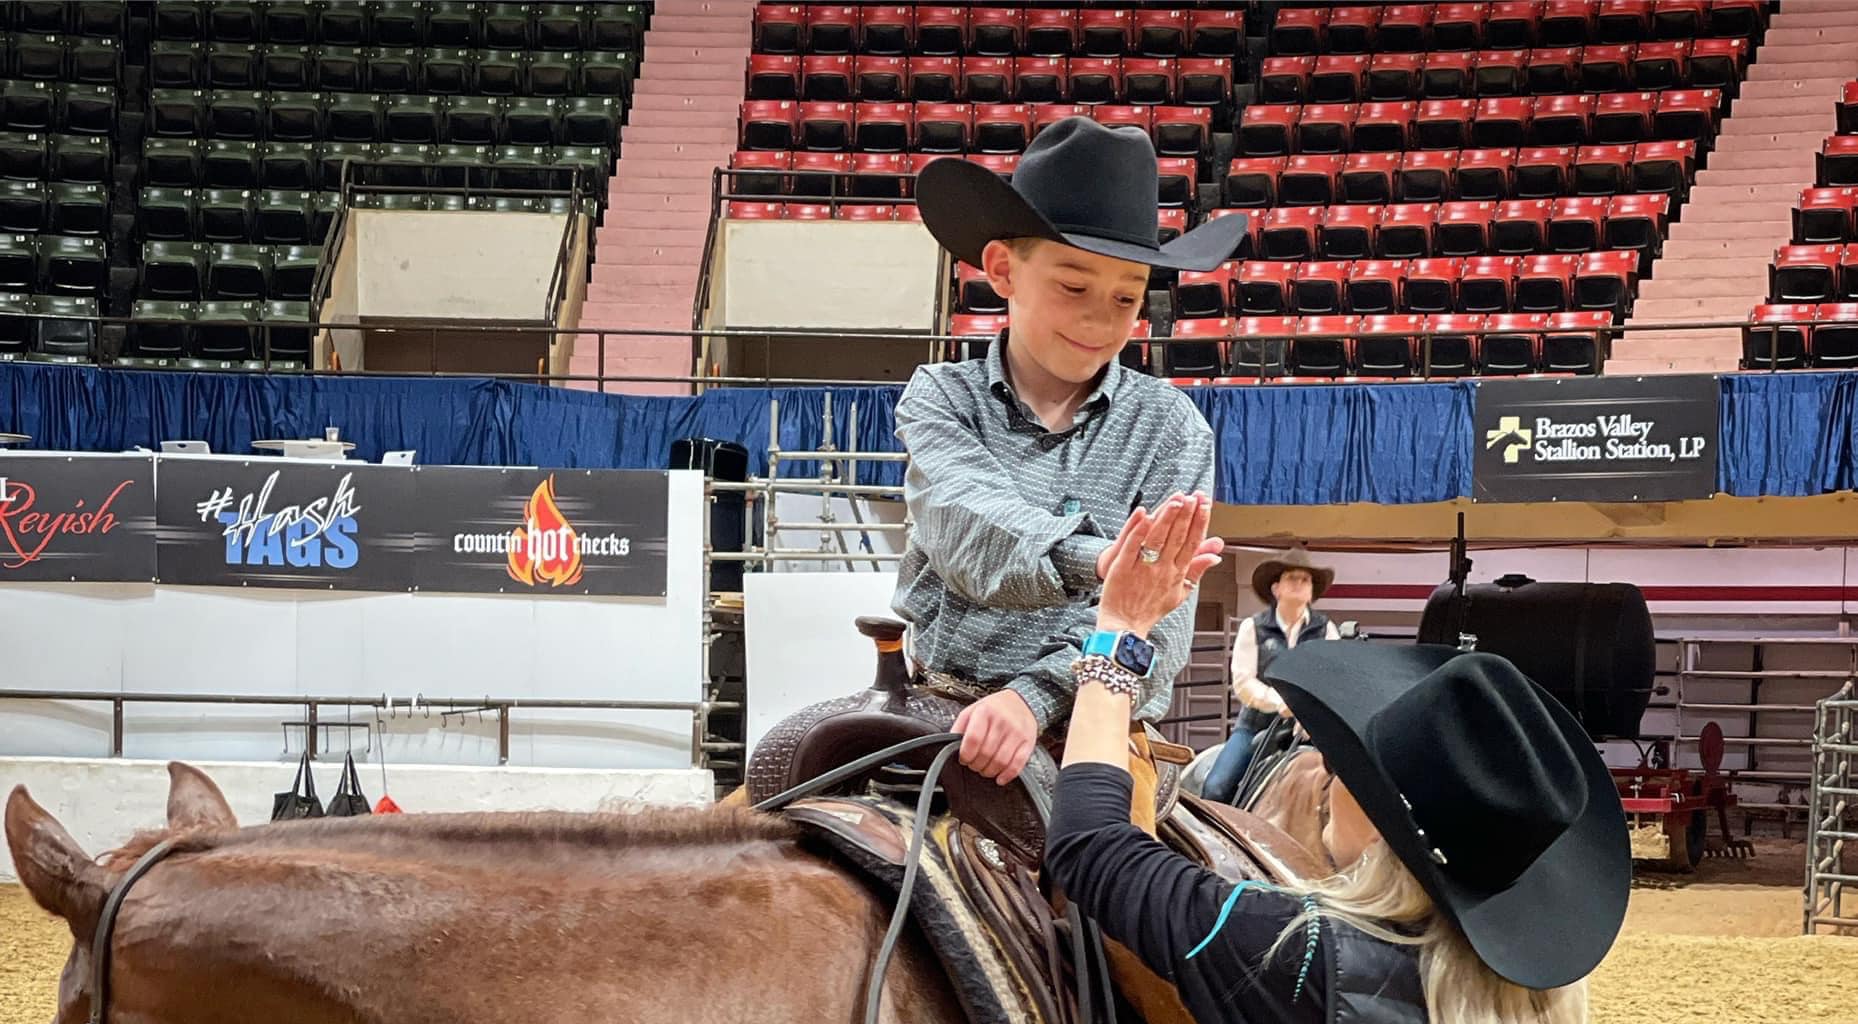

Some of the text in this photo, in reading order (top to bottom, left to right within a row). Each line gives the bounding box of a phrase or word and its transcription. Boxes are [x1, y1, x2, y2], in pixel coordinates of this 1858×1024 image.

[1534, 437, 1706, 462] Stallion Station, LP
[1535, 414, 1654, 441] Brazos Valley
[0, 480, 135, 568] Reyish
[197, 470, 362, 548] #Hash
[218, 511, 359, 569] TAGS
[454, 517, 631, 569] countin hot checks
